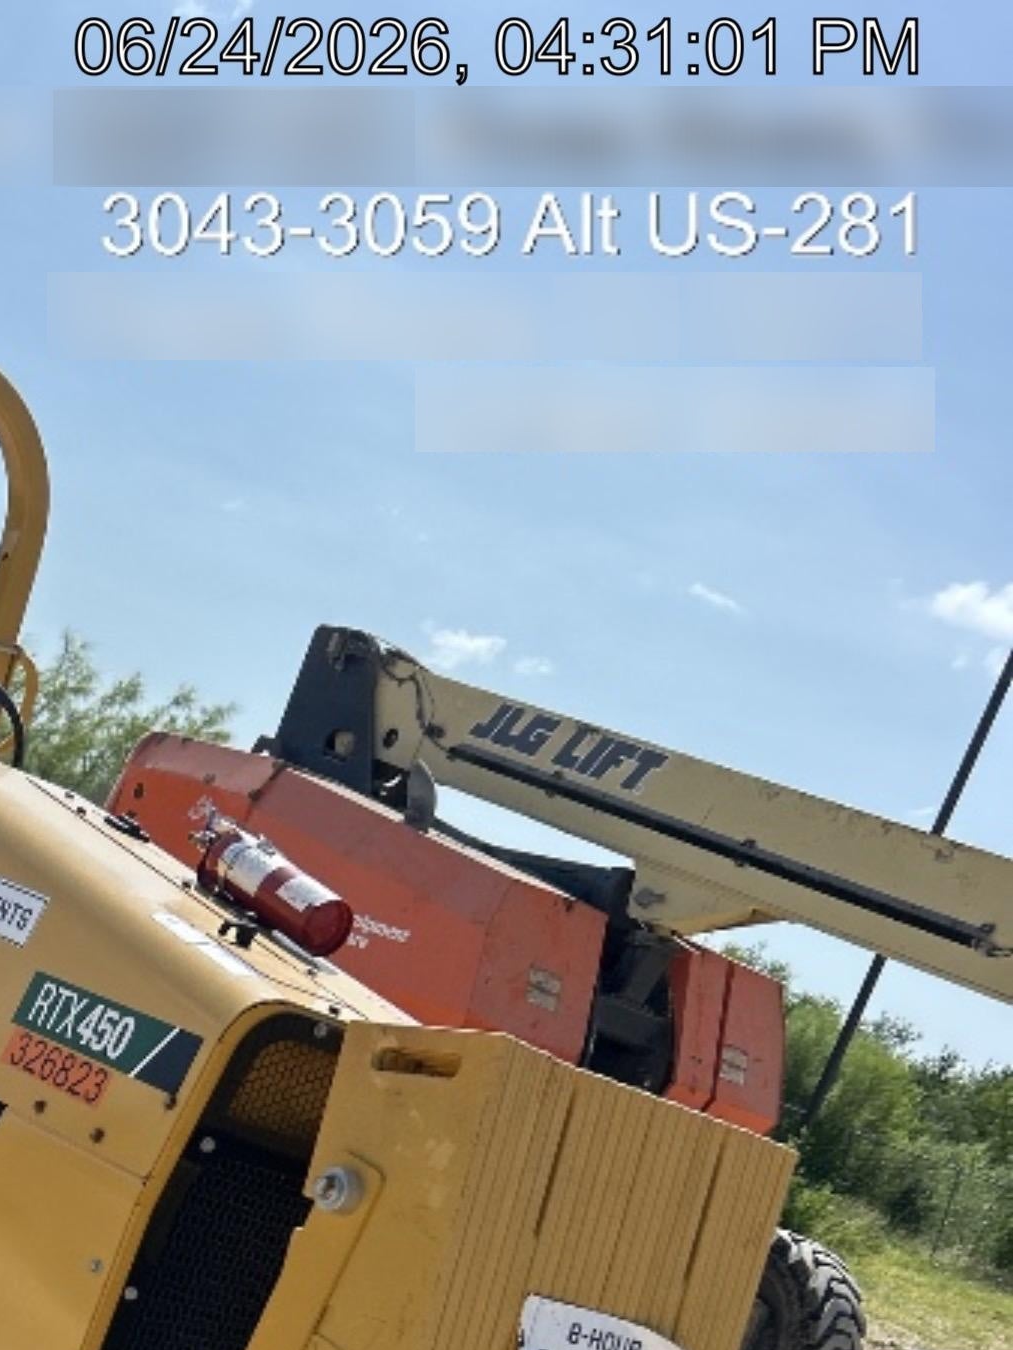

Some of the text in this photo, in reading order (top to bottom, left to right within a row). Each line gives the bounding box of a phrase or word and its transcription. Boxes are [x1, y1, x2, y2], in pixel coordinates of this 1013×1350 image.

[469, 702, 669, 791] JLG LIFT
[28, 981, 135, 1059] RTX450
[9, 1034, 109, 1103] 326823
